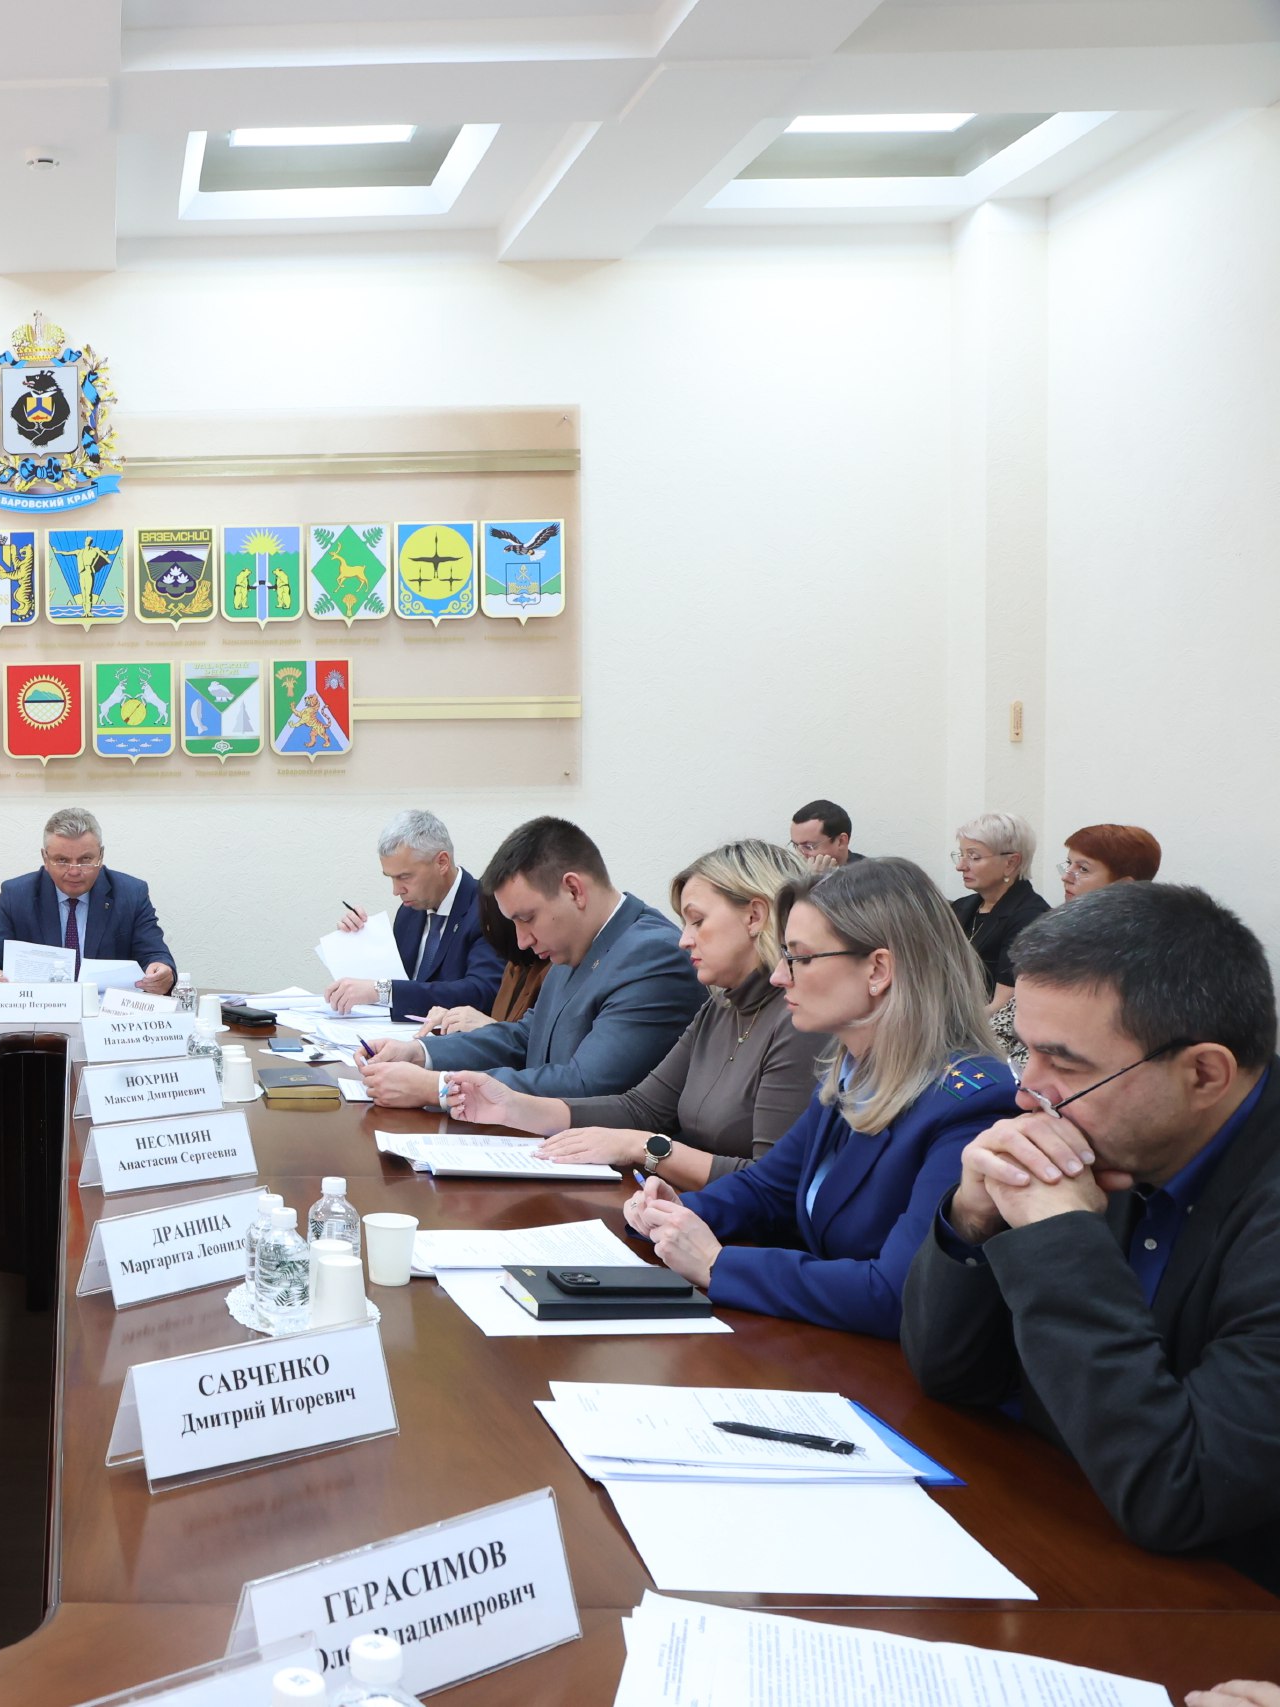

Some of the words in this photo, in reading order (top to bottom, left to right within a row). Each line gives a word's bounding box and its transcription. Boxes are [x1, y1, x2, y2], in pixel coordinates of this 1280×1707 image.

[67, 489, 95, 504] КРАЙ
[19, 991, 33, 1000] ЯЦ
[29, 1001, 67, 1009] Петрович
[121, 998, 155, 1011] КРАВЦОВ
[111, 1020, 172, 1033] МУРАТОВА
[104, 1035, 141, 1046] Наталья
[142, 1033, 184, 1045] Фуатовна
[126, 1072, 179, 1088] НОХРИН
[104, 1094, 144, 1106] Максим
[147, 1086, 206, 1102] Дмитриевич
[135, 1129, 212, 1150] НЕСМИЯН
[118, 1155, 178, 1172] Анастасия
[181, 1147, 238, 1166] Сергеевна
[152, 1214, 232, 1247] ДРАНИЦА
[120, 1250, 194, 1276] Маргарита
[198, 1354, 330, 1397] САВЧЕНКО
[181, 1401, 266, 1438] Дмитрий
[270, 1387, 357, 1416] Игоревич
[322, 1540, 507, 1624] ГЕРАСИМОВ
